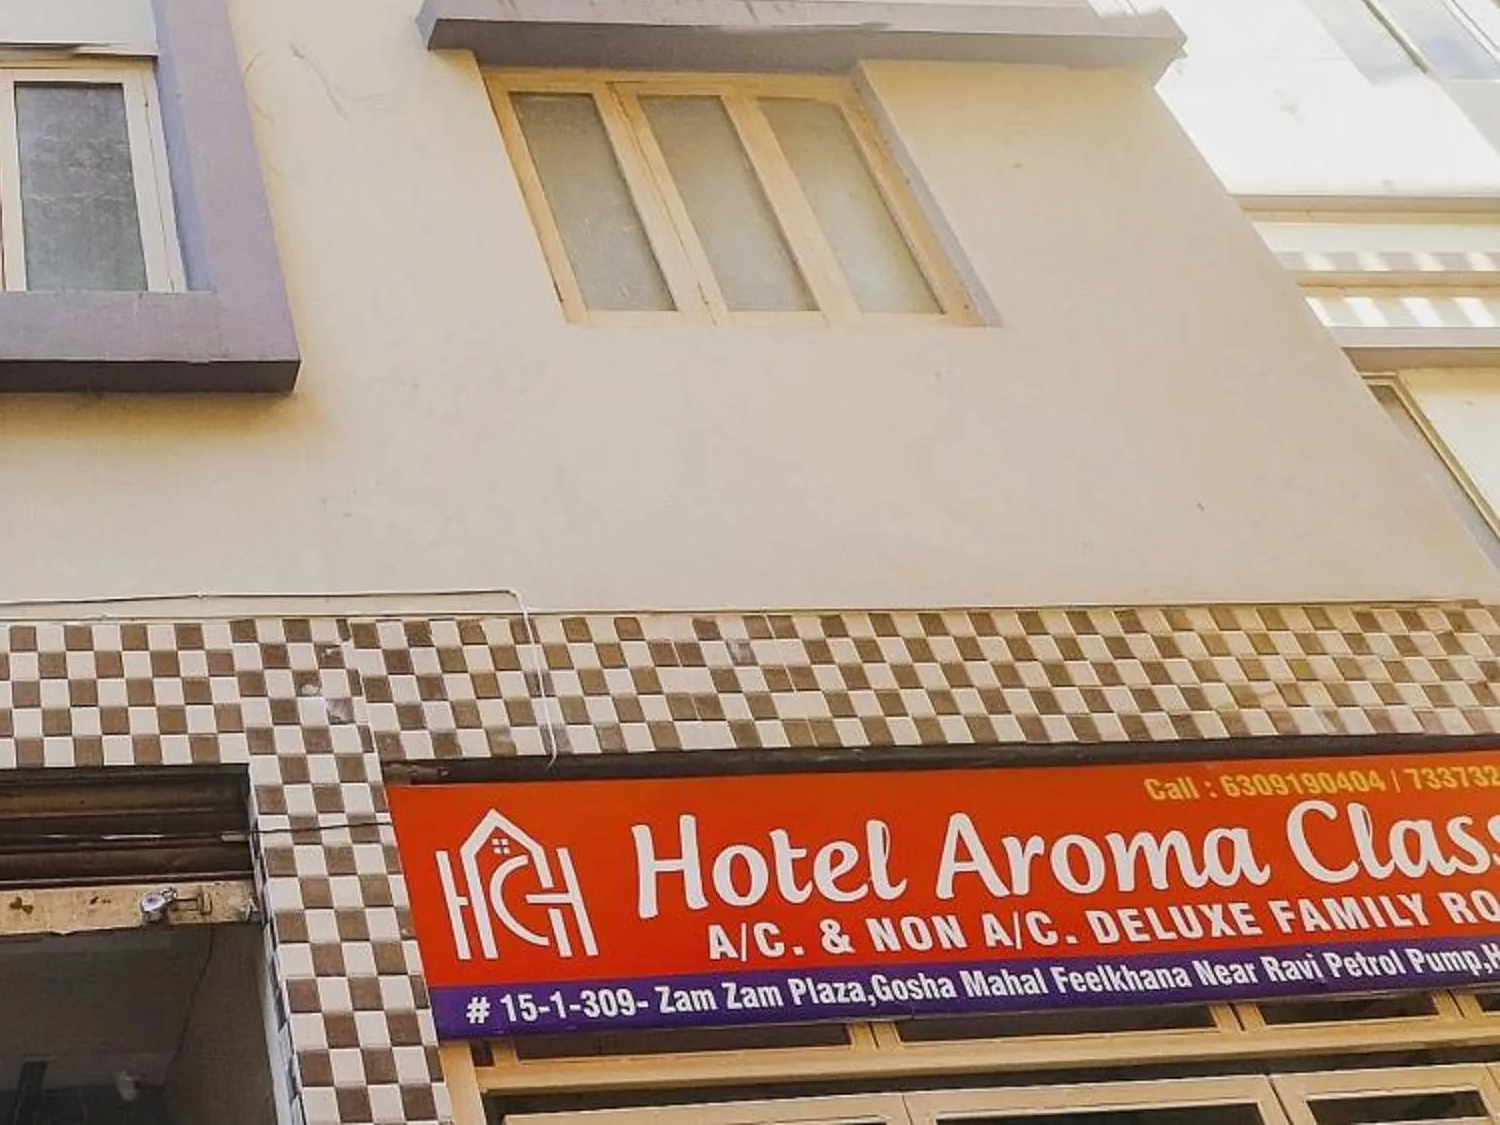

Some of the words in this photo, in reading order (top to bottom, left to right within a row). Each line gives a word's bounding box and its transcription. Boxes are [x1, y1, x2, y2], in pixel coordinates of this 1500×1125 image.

[1144, 776, 1200, 801] Call
[1223, 767, 1385, 799] 6309190404
[630, 813, 908, 919] Hotel
[935, 812, 1271, 899] Aroma
[1286, 799, 1500, 883] Clas
[708, 919, 805, 962] A/C.
[820, 919, 854, 955] &
[866, 913, 968, 953] NON
[981, 908, 1077, 951] A/C.
[1086, 900, 1263, 944] DELUXE
[1267, 893, 1431, 935] FAMILY
[465, 997, 490, 1025] #
[500, 990, 649, 1023] 15-1-309-
[653, 983, 717, 1015] Zam
[721, 980, 784, 1011] Zam
[959, 967, 1050, 1000] Mahal
[1052, 958, 1193, 995] Feelkhana
[1197, 955, 1260, 987] Near
[1264, 948, 1323, 981] Ravi
[1329, 943, 1406, 979] Petrol
